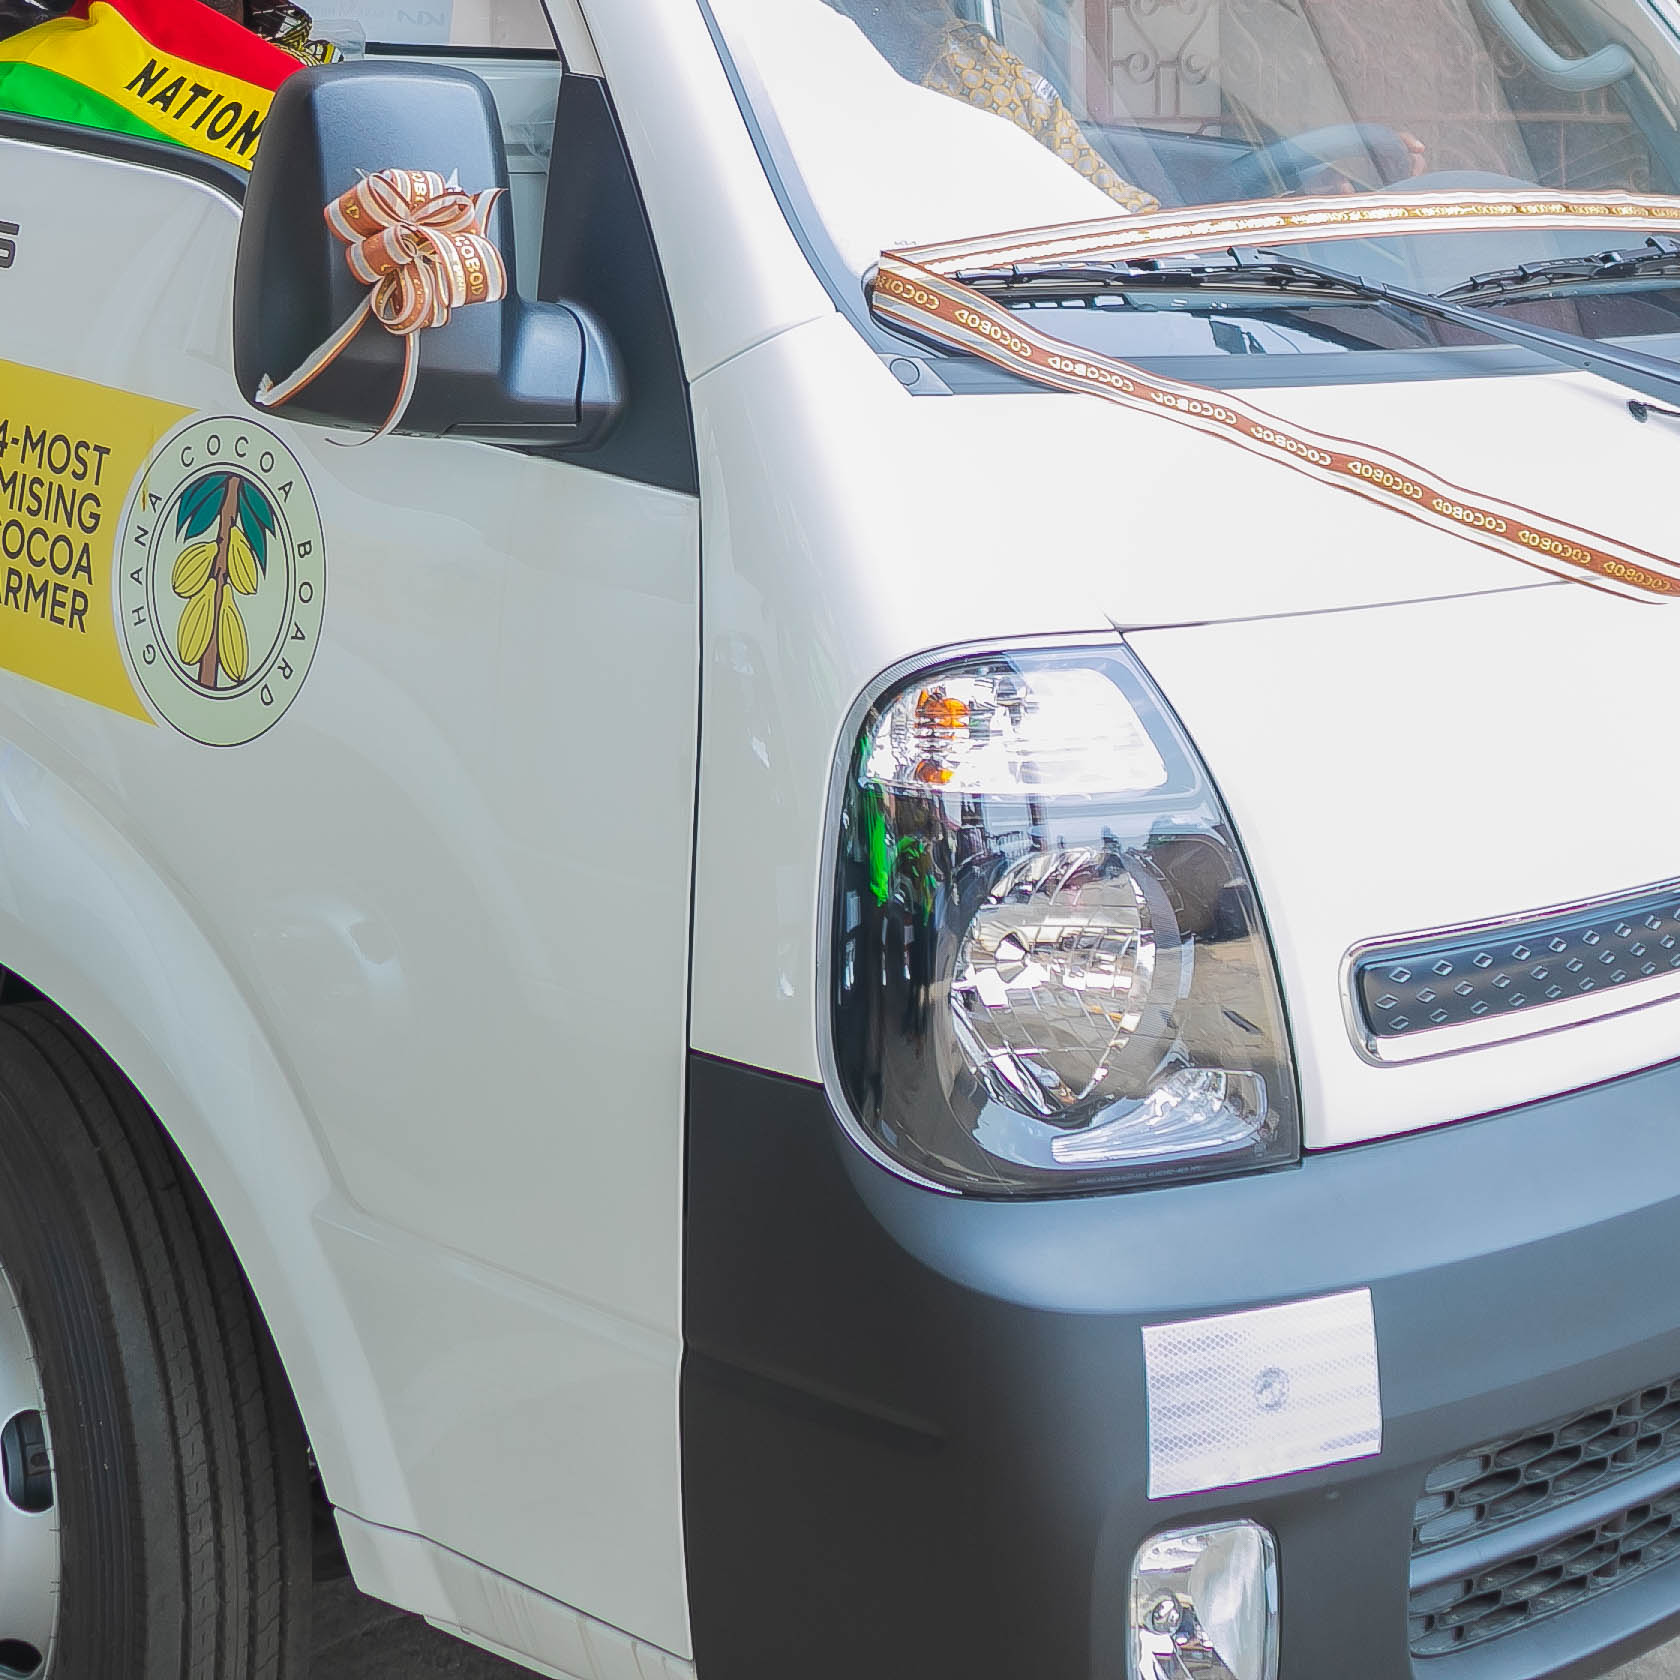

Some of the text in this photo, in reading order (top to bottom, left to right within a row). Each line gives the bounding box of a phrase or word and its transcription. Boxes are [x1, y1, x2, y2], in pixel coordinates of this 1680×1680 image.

[123, 58, 267, 160] NATION
[954, 308, 1033, 358] COCOBOD
[1048, 356, 1135, 392] COCOBOD
[1347, 461, 1423, 500] COCOBOD
[1432, 498, 1507, 533] COCOBOD
[130, 433, 314, 707] GHANA COCOA BOARD
